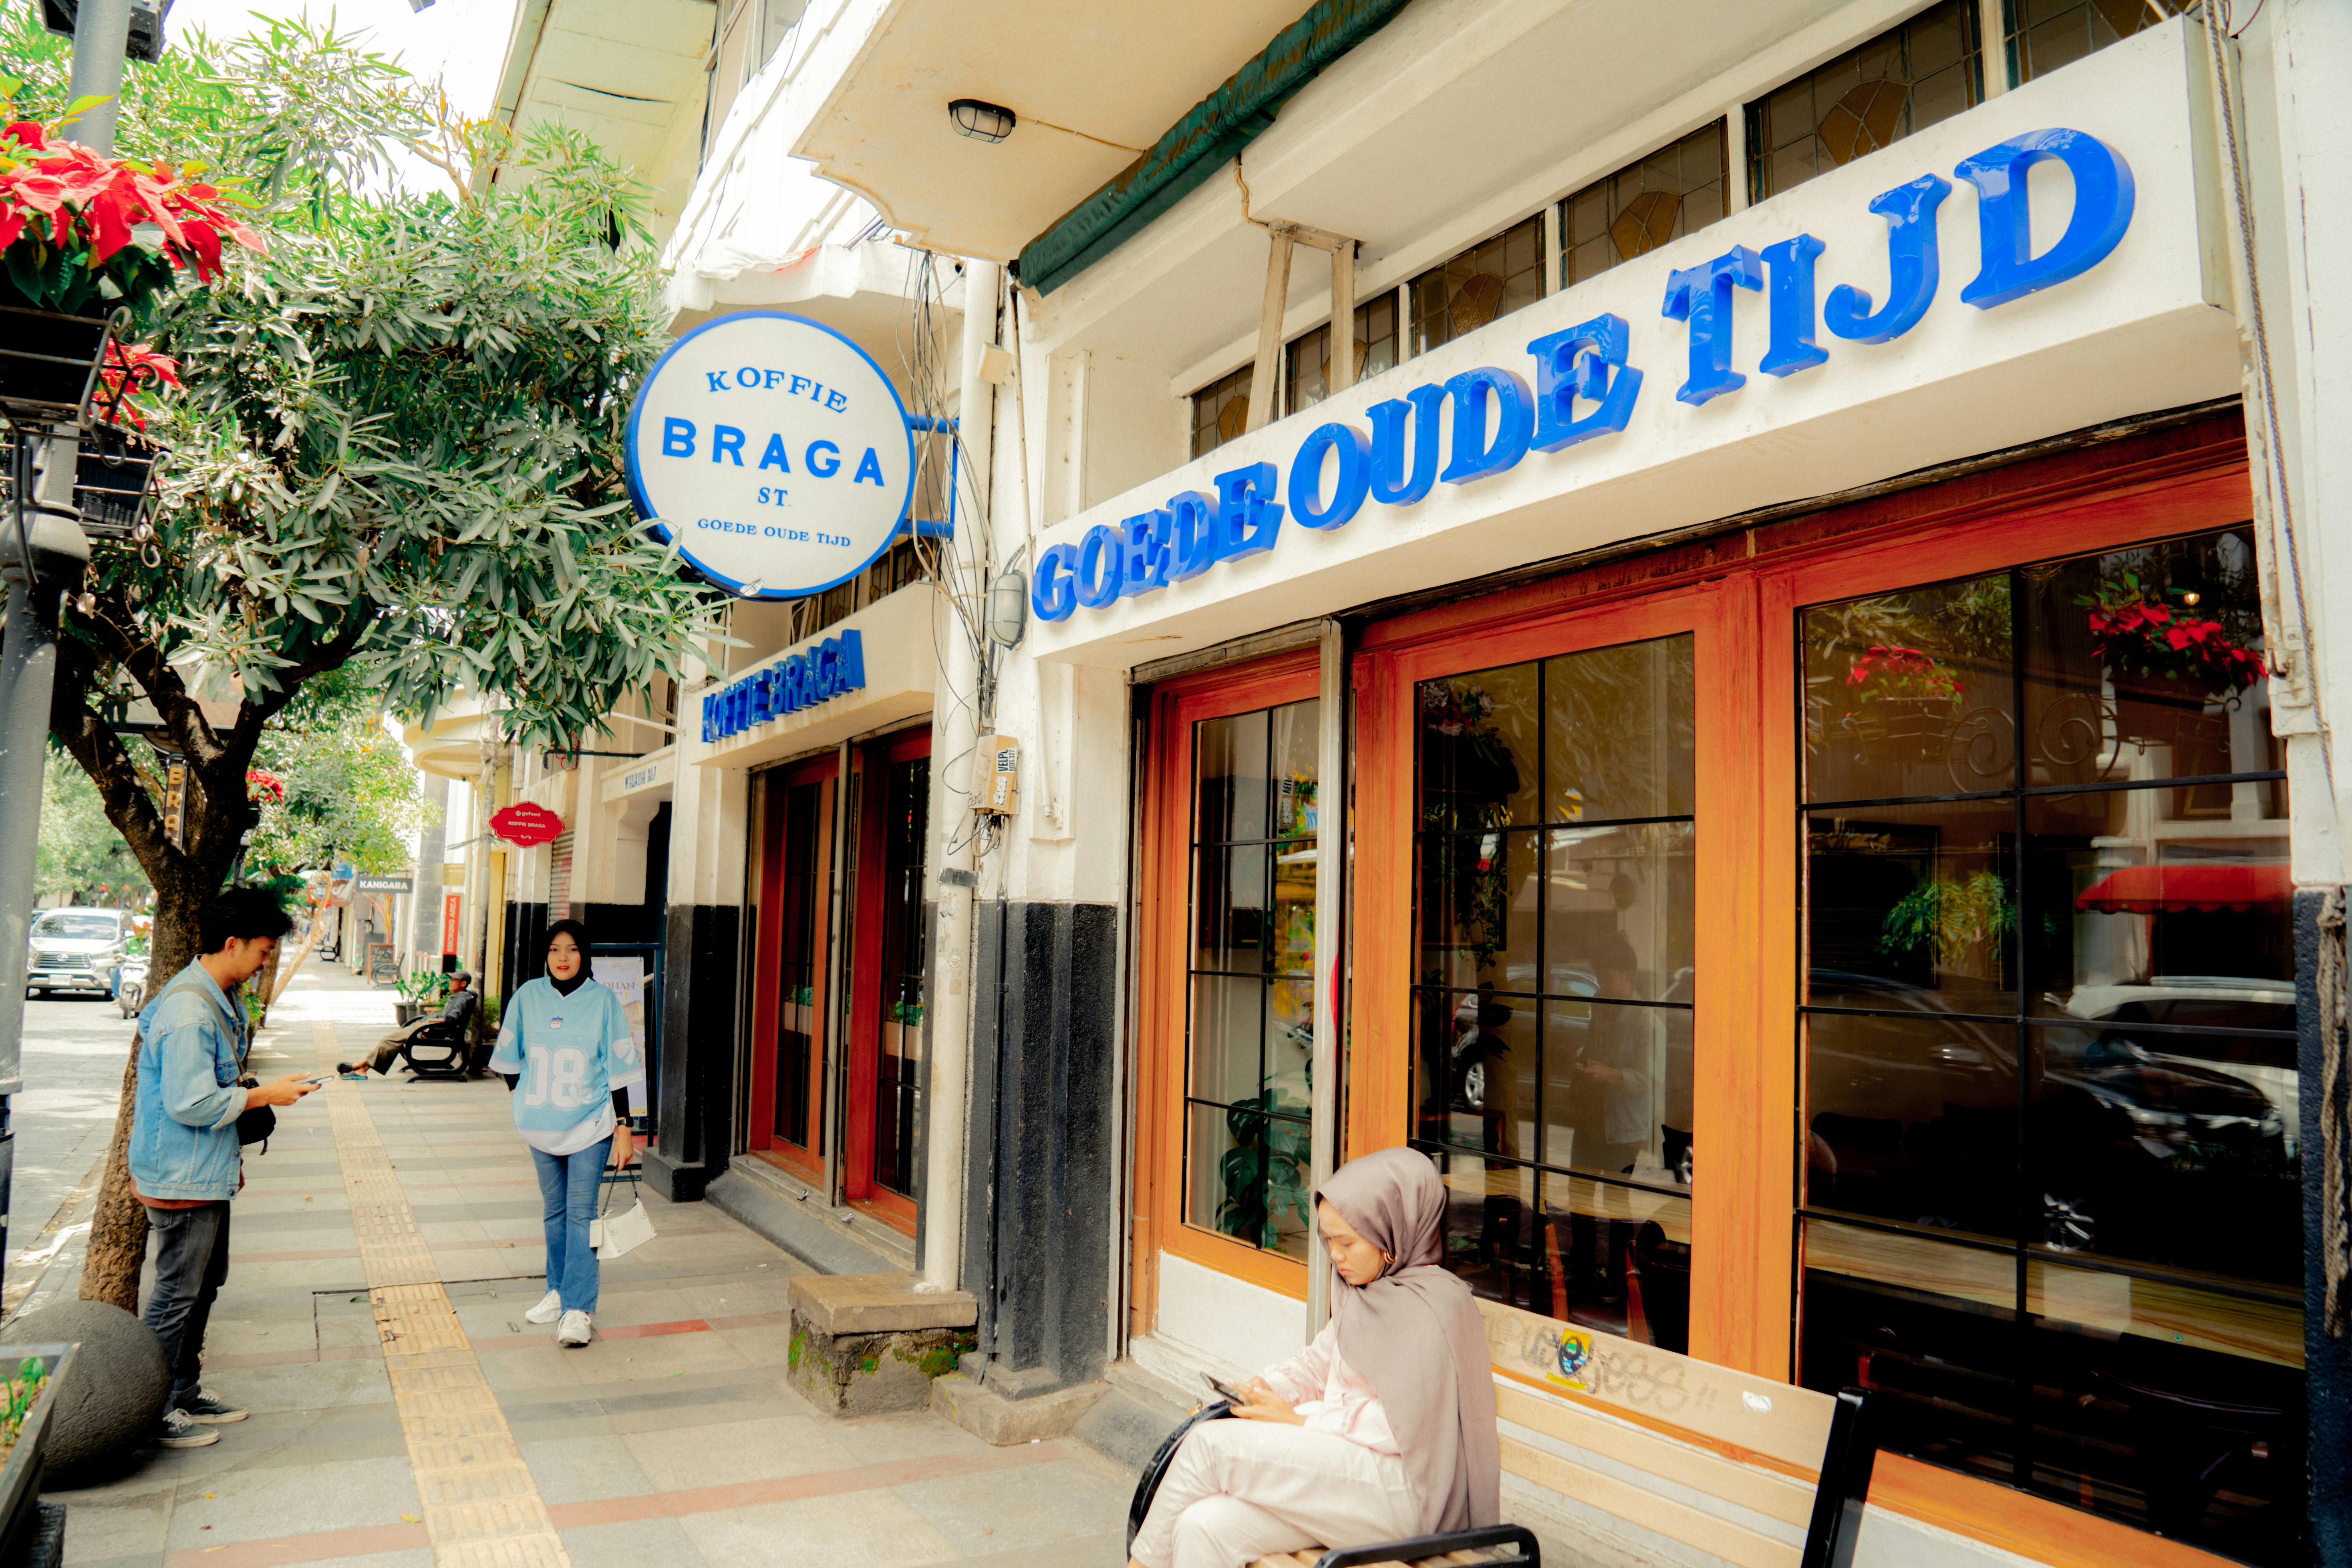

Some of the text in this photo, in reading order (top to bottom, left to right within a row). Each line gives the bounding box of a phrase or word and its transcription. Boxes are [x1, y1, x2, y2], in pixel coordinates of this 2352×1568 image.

[706, 366, 848, 414] KOFFIE
[1031, 127, 2136, 623] GOEDE OUDE TIJD
[662, 416, 885, 487] BRAGA
[757, 487, 788, 507] ST
[697, 518, 851, 547] GOEDE OUDE TIJD
[701, 629, 866, 744] KOFFIE BRAGA
[164, 767, 185, 844] BRA
[359, 880, 409, 890] KANIGARA
[446, 897, 457, 953] SMOKING AREA
